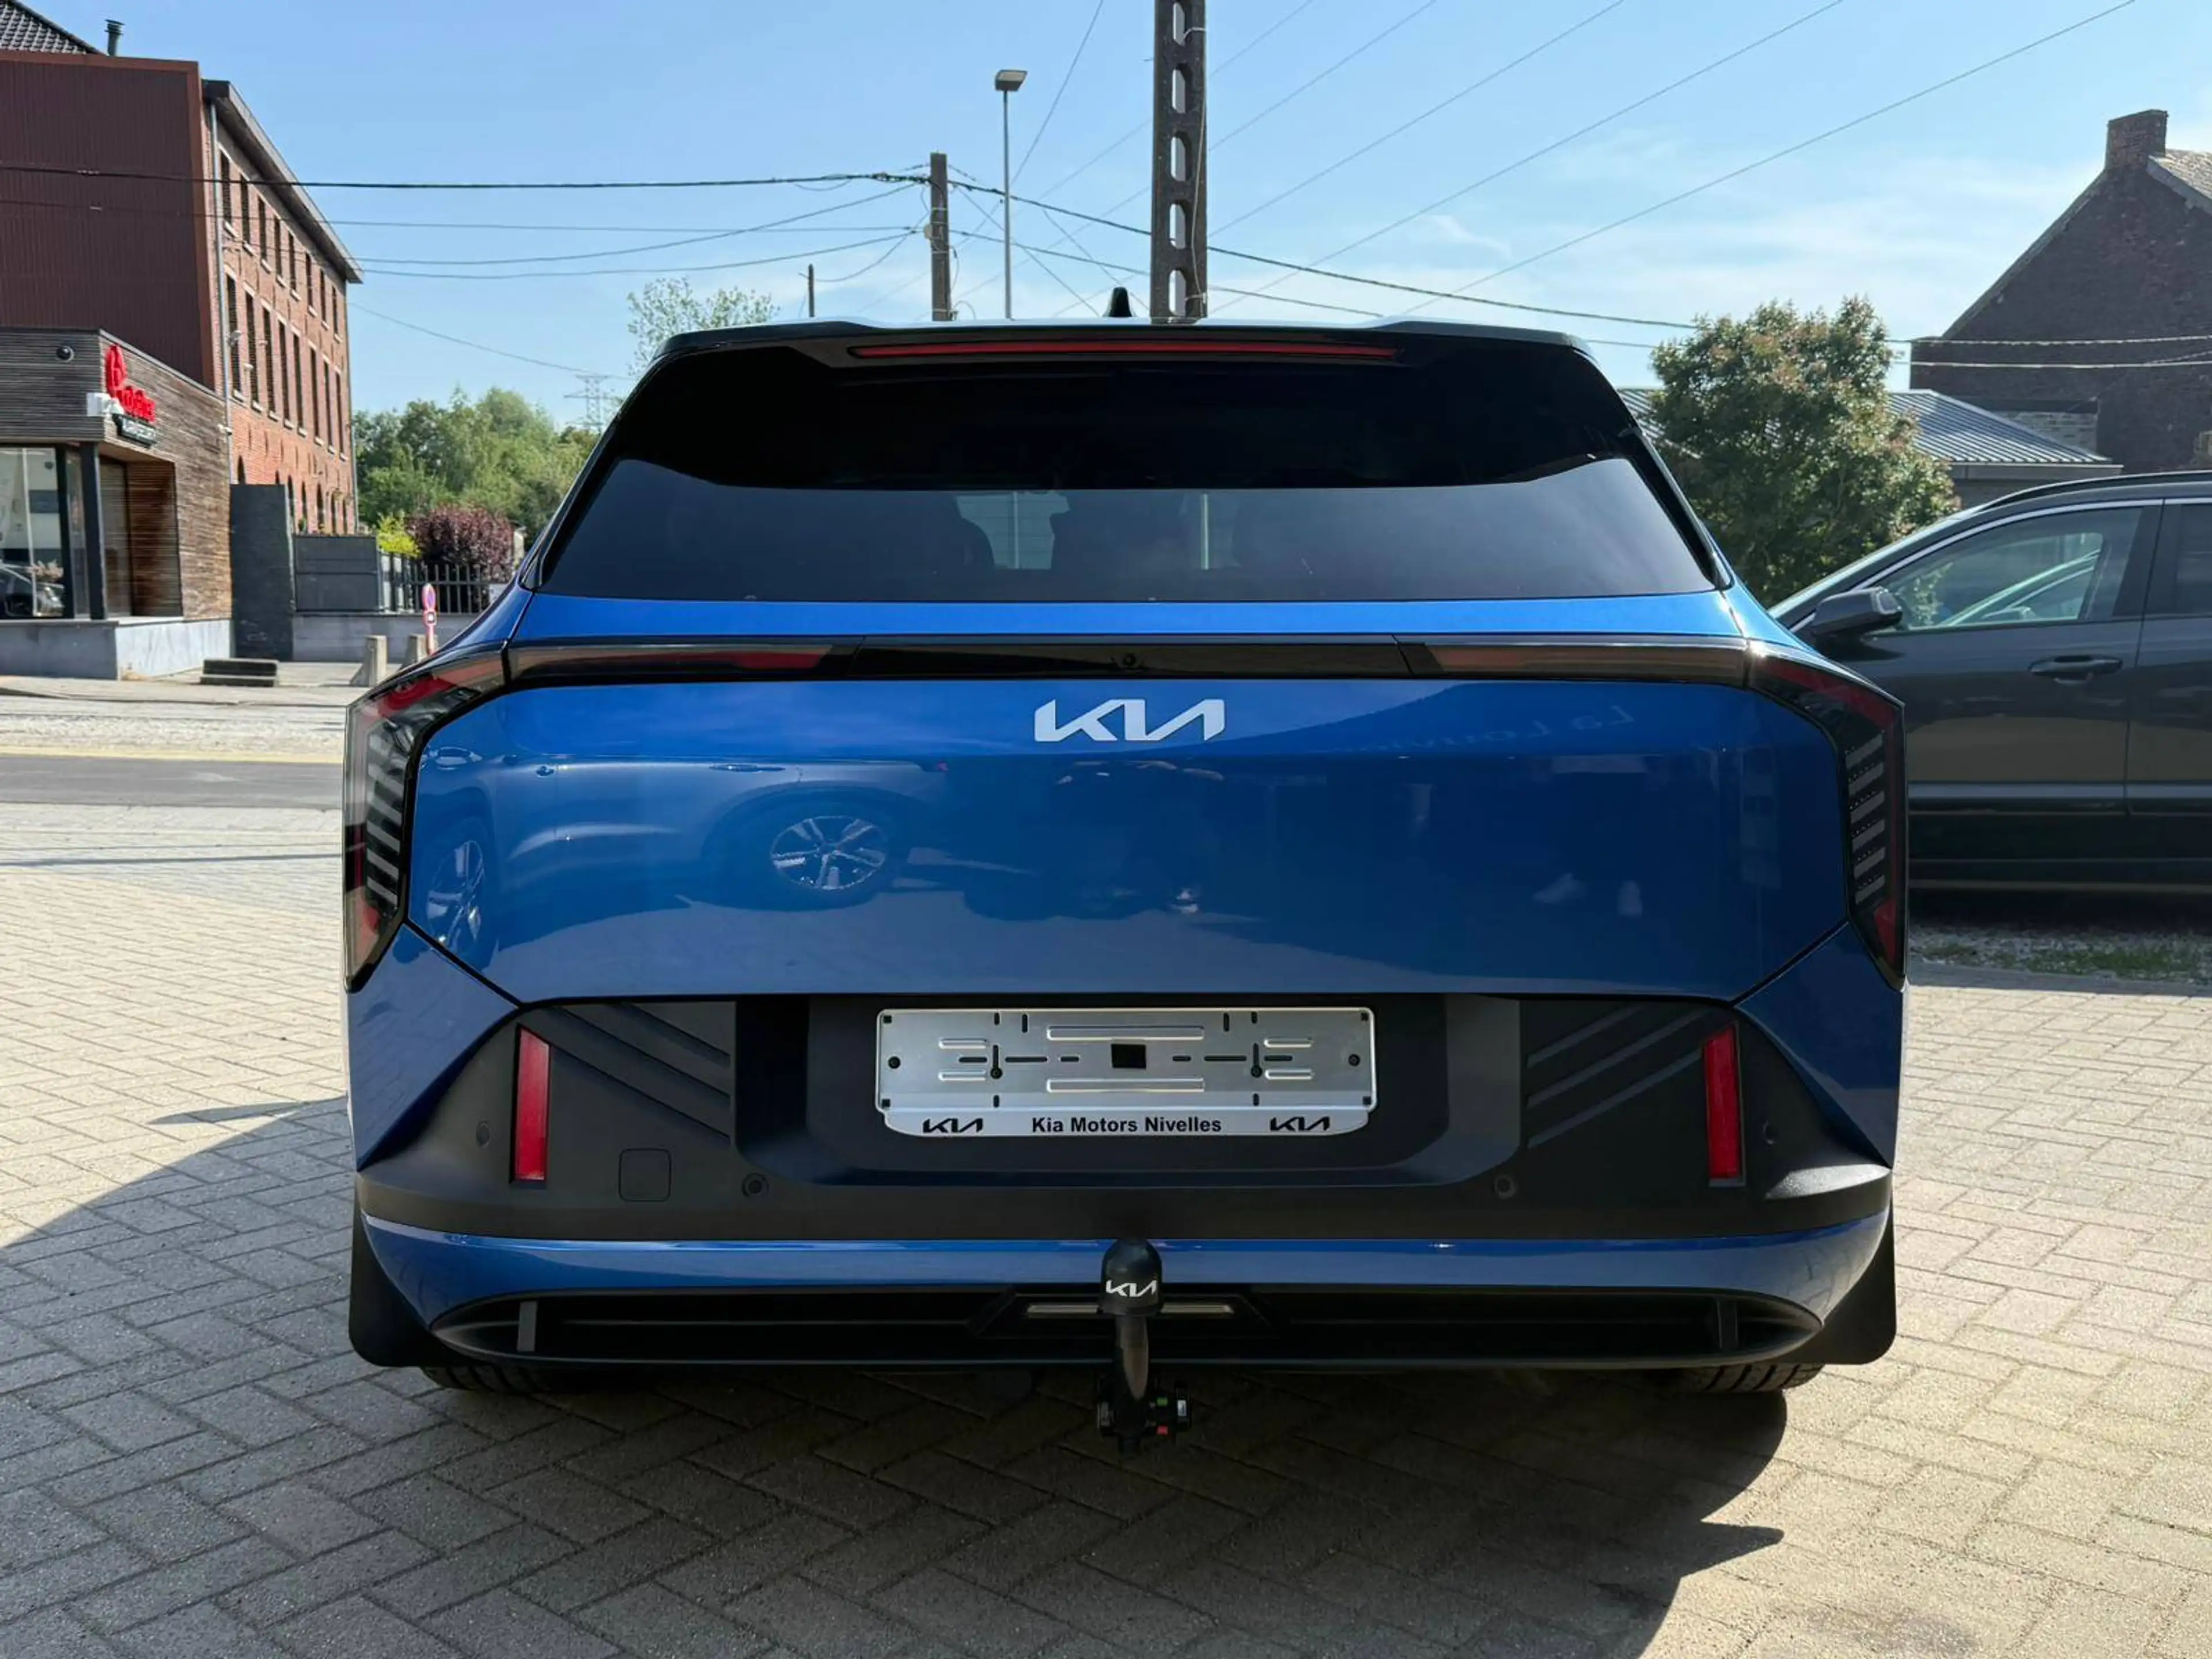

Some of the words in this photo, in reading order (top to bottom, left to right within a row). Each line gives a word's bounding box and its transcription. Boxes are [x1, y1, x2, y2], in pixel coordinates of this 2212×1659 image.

[1034, 699, 1225, 742] KIA
[922, 1118, 983, 1134] KIA
[1032, 1117, 1063, 1133] Kia
[1071, 1117, 1138, 1132] Motors
[1145, 1116, 1222, 1132] Nivelles
[1269, 1116, 1331, 1132] KIA
[1105, 1280, 1157, 1297] KIA
